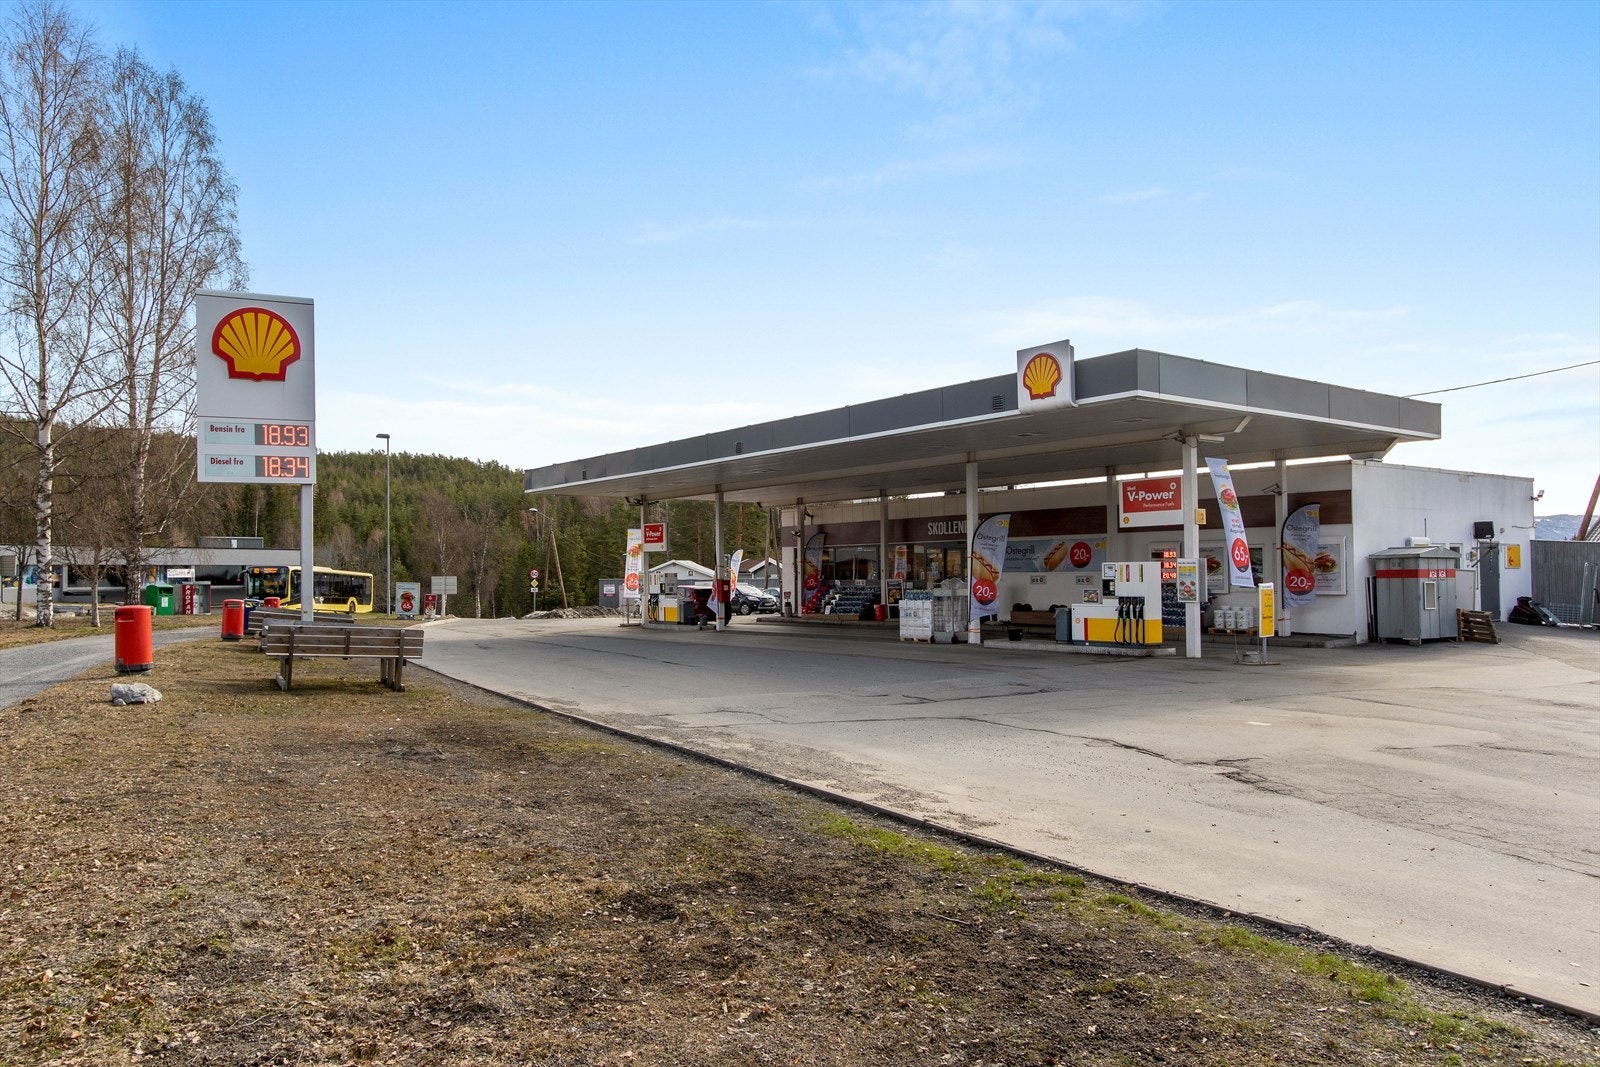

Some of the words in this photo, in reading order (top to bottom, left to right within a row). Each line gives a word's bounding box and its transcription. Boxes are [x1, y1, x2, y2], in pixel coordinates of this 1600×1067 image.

[209, 424, 233, 433] Bensin
[235, 425, 245, 433] fra
[262, 424, 309, 447] 18.93
[210, 457, 232, 465] Diesel
[233, 457, 244, 466] fra
[262, 456, 309, 478] 18.34
[1127, 490, 1175, 502] V-Power
[1286, 524, 1317, 534] Ostegrill
[976, 532, 1006, 543] Ostegrill
[1006, 544, 1035, 557] Ostegrill
